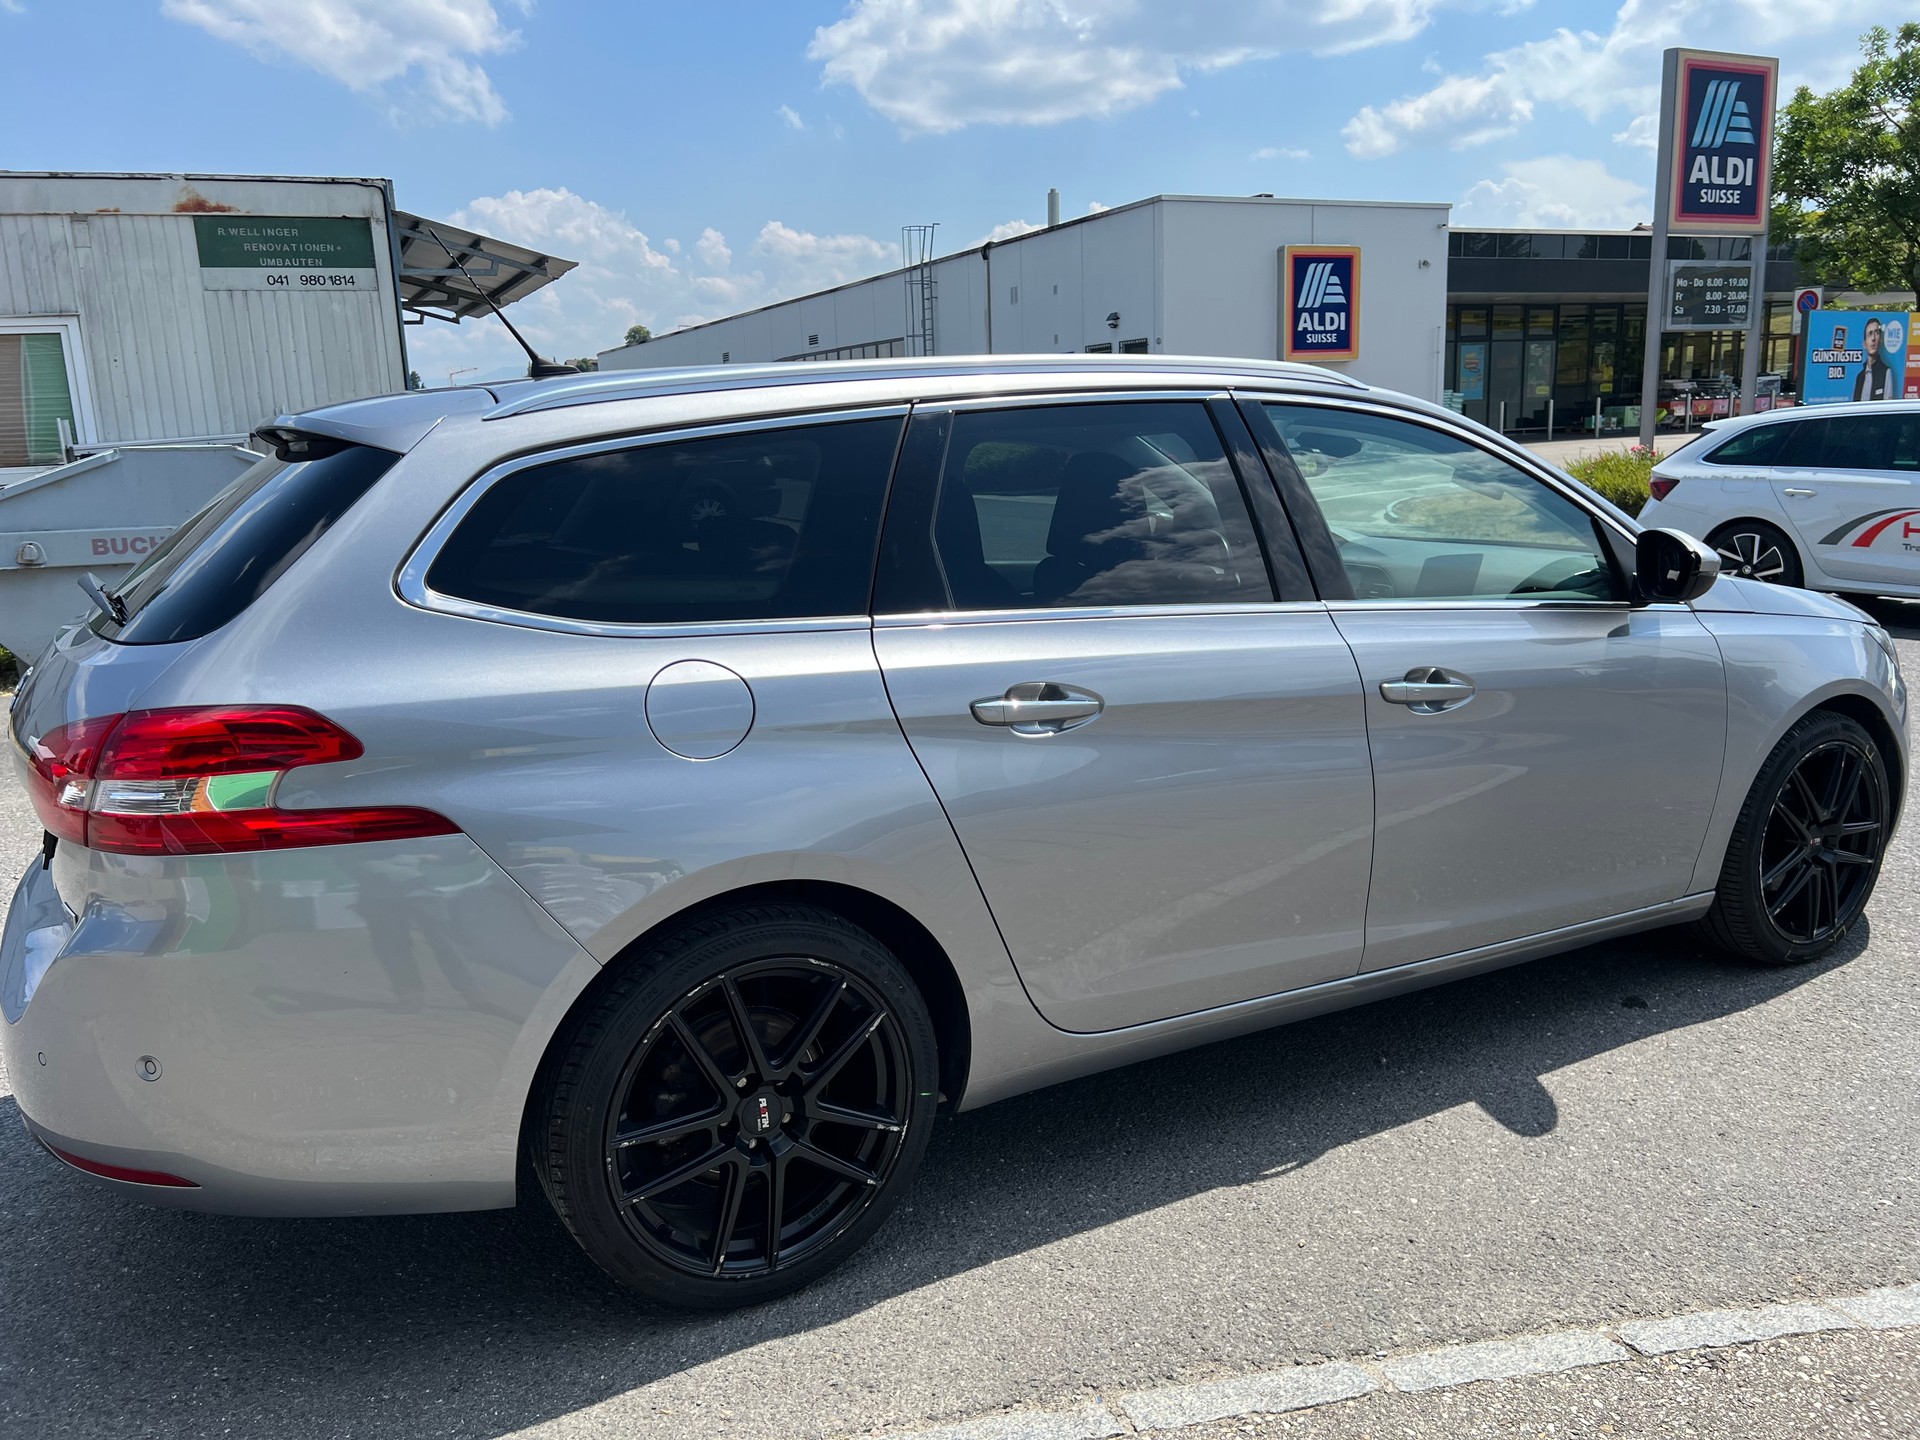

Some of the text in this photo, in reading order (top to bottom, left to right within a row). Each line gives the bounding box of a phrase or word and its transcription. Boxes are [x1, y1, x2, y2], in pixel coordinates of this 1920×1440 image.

[1689, 155, 1754, 186] ALDI
[1700, 188, 1741, 204] SUISSE
[228, 227, 299, 237] WELLINGER
[243, 243, 335, 252] RENOVATIONEN
[259, 258, 323, 267] UMBAUTEN
[266, 274, 289, 286] 041
[1676, 278, 1688, 287] Mo
[1693, 278, 1704, 287] Do
[1706, 278, 1723, 287] 8.00
[1728, 278, 1749, 287] 19.00
[1675, 292, 1684, 301] Fr
[1705, 291, 1722, 301] 8.00
[1727, 291, 1747, 300] 20.00
[1674, 305, 1684, 315] Sa
[1704, 305, 1721, 314] 7.30
[1726, 304, 1747, 314] 17.00
[1297, 312, 1346, 331] ALDI
[1306, 333, 1338, 344] SUISSE
[1812, 348, 1863, 363] GÜNSTIGSTES
[1828, 367, 1845, 379] BIO.
[758, 1097, 770, 1129] PLATIN
